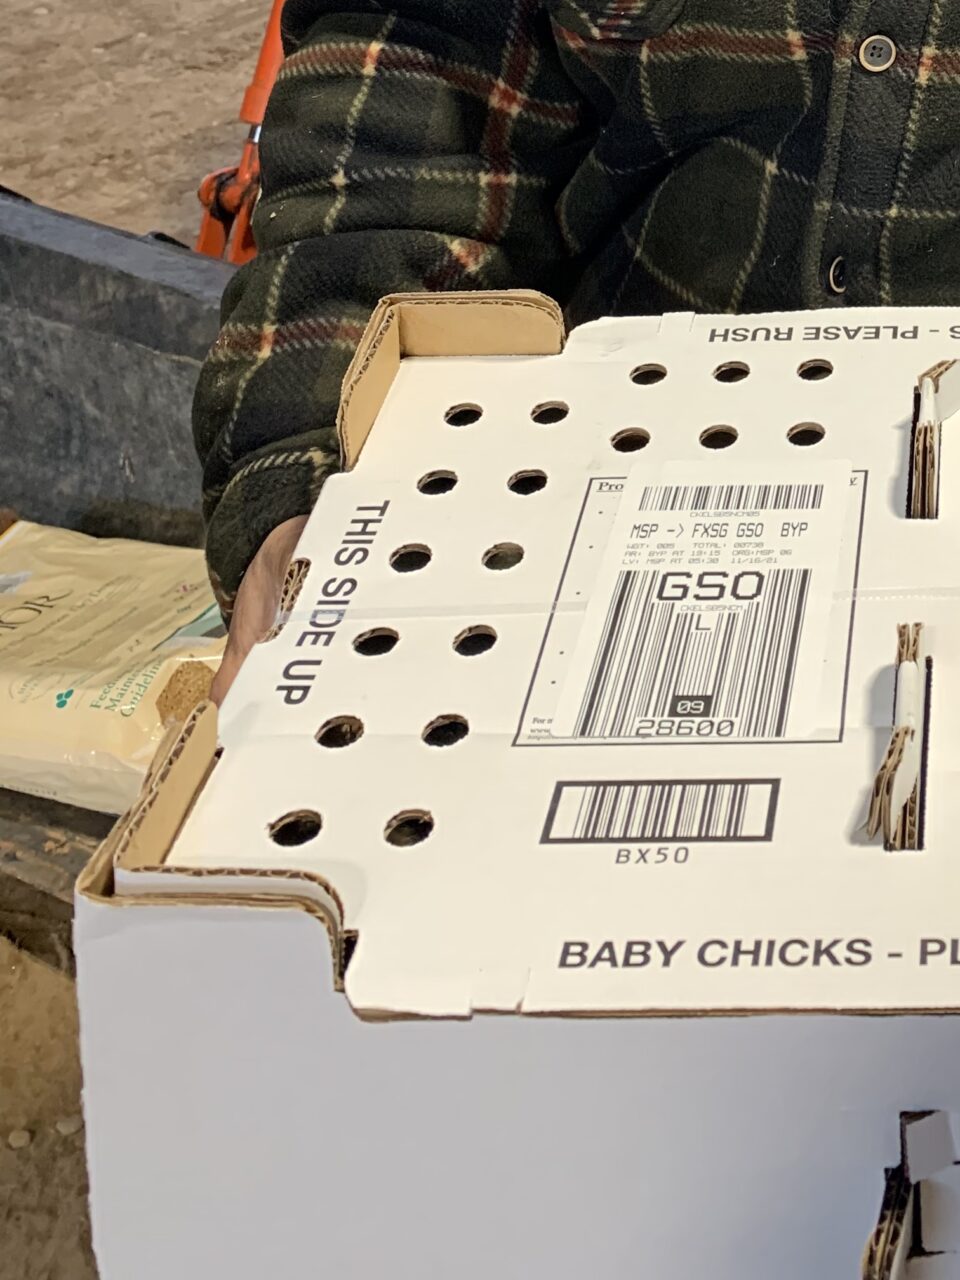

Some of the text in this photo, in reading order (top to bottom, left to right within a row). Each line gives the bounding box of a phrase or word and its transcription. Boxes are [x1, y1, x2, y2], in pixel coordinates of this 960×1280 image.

[708, 327, 793, 342] RUSH
[803, 326, 919, 341] PLEASE
[629, 523, 659, 539] MSP
[691, 523, 730, 538] FXSG
[736, 522, 765, 538] GSO
[780, 522, 808, 537] BYP
[656, 571, 765, 600] GSO
[275, 499, 391, 705] THIS SIDE UP
[676, 700, 704, 714] 09
[635, 719, 735, 738] 28600
[615, 847, 689, 865] BX50
[557, 939, 687, 968] BABY
[697, 938, 873, 967] CHICKS
